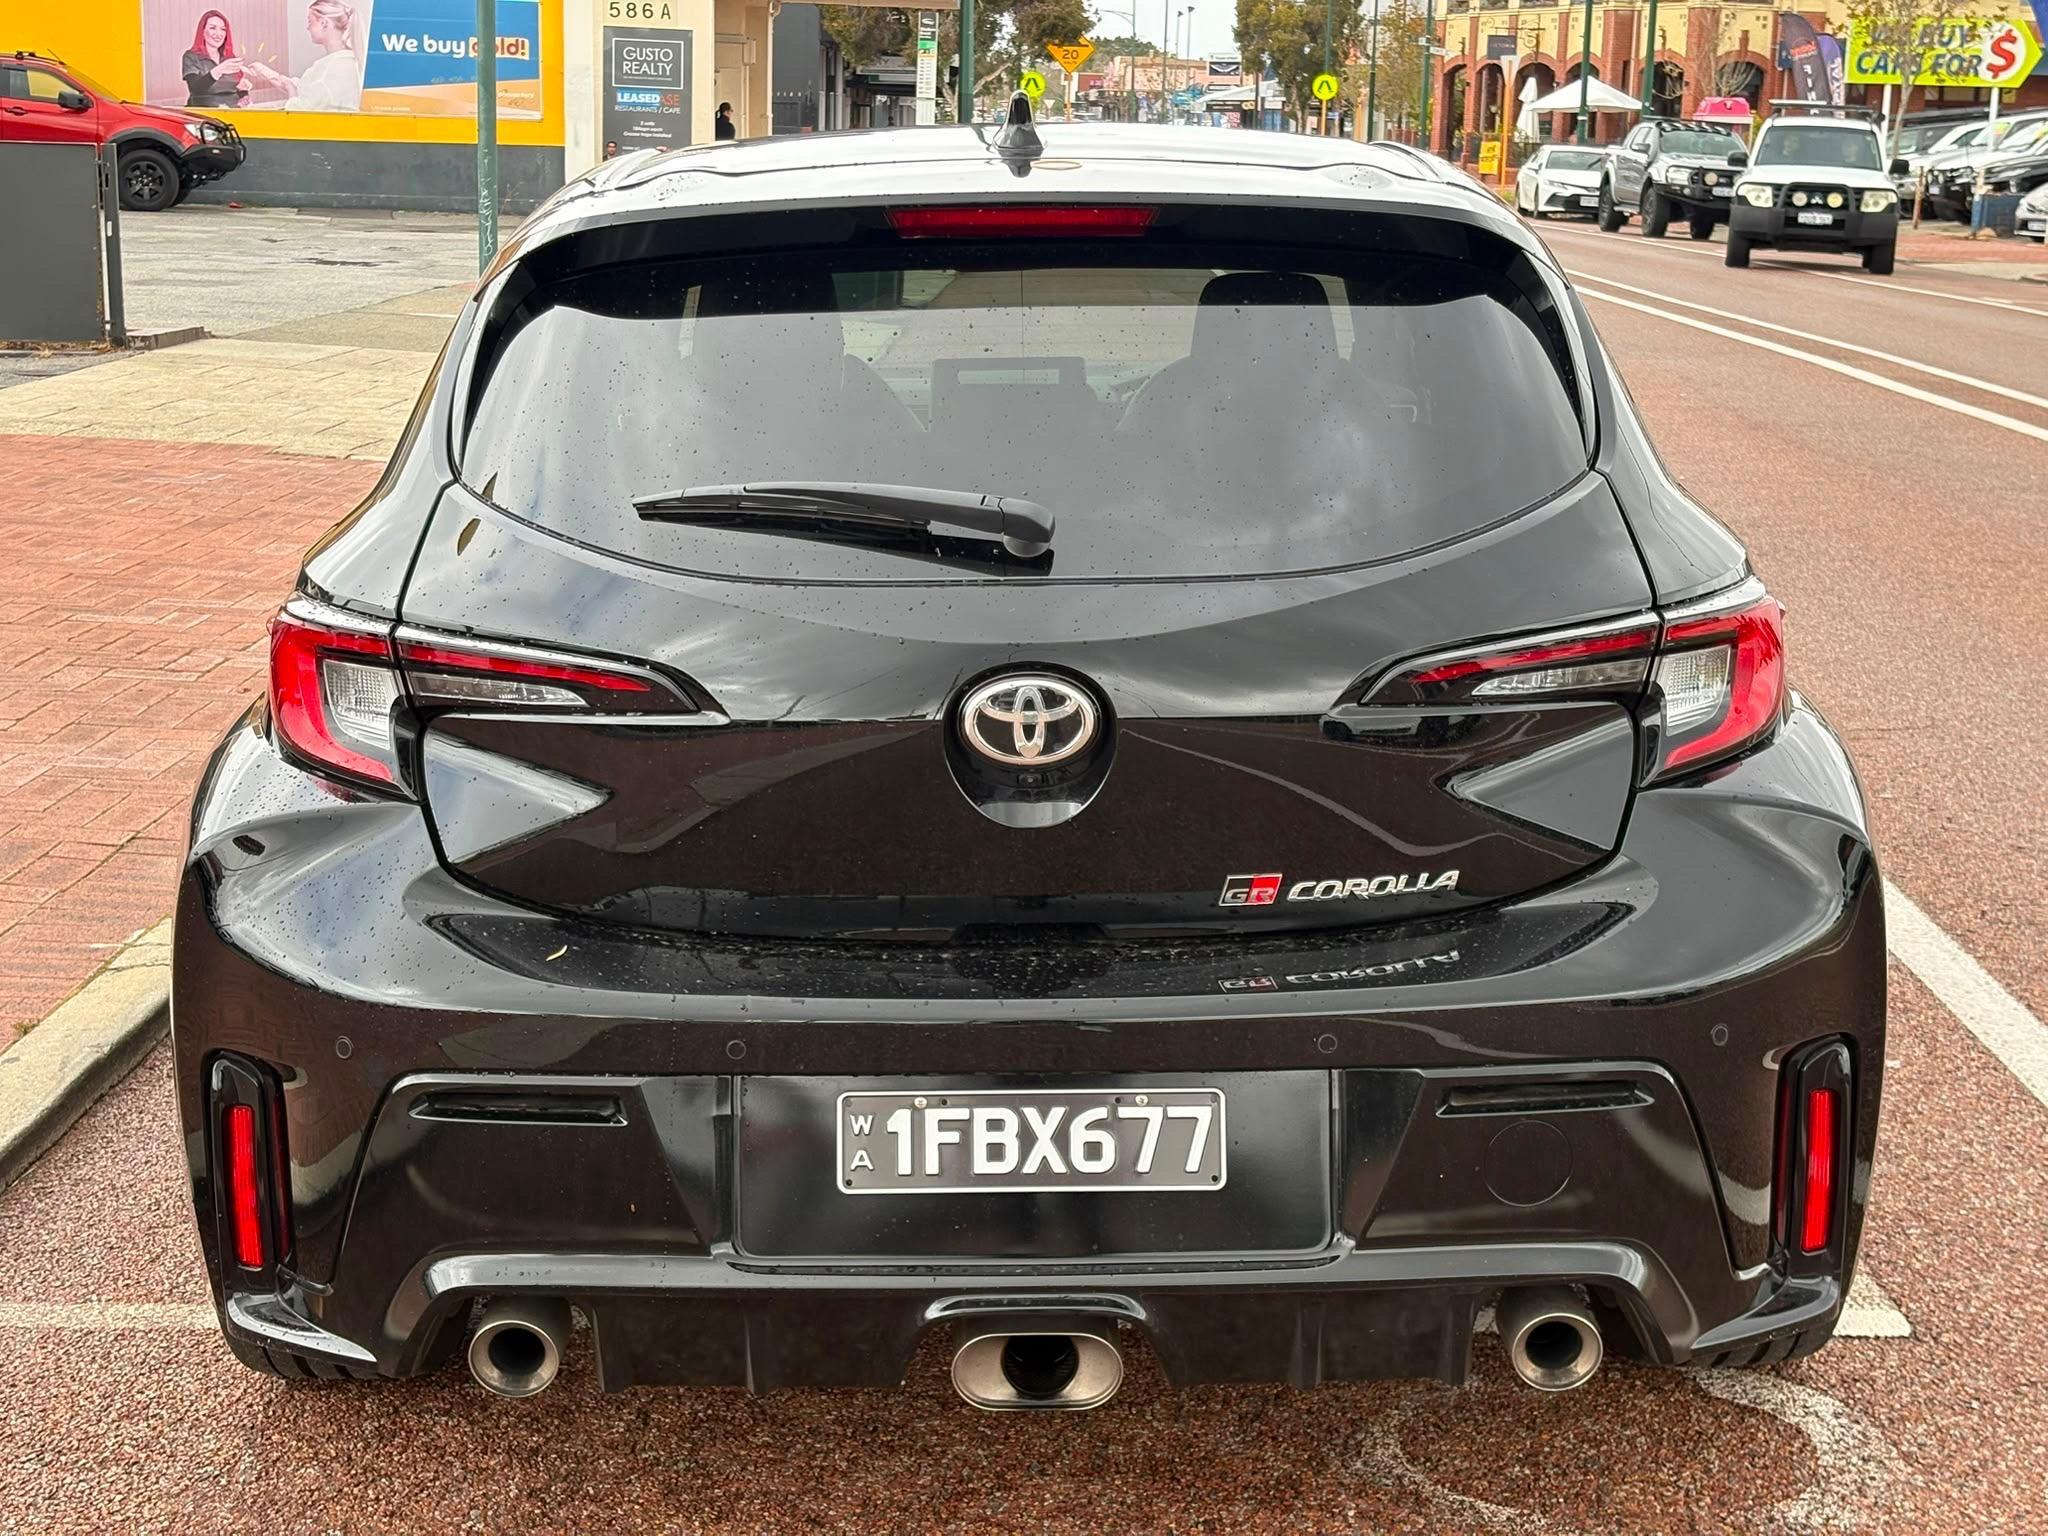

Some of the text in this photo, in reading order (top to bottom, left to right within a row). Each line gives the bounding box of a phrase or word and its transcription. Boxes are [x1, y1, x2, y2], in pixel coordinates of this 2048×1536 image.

[609, 2, 671, 20] 586A
[381, 33, 526, 58] We buy ld!
[623, 47, 673, 62] GUSTO
[1931, 53, 1983, 77] FOR
[1986, 28, 2017, 79] $
[1062, 50, 1079, 60] 20
[622, 62, 673, 76] REALTY
[616, 91, 660, 103] LEASED
[1286, 870, 1460, 901] COROLLA
[885, 1105, 1213, 1176] 1FBX677
